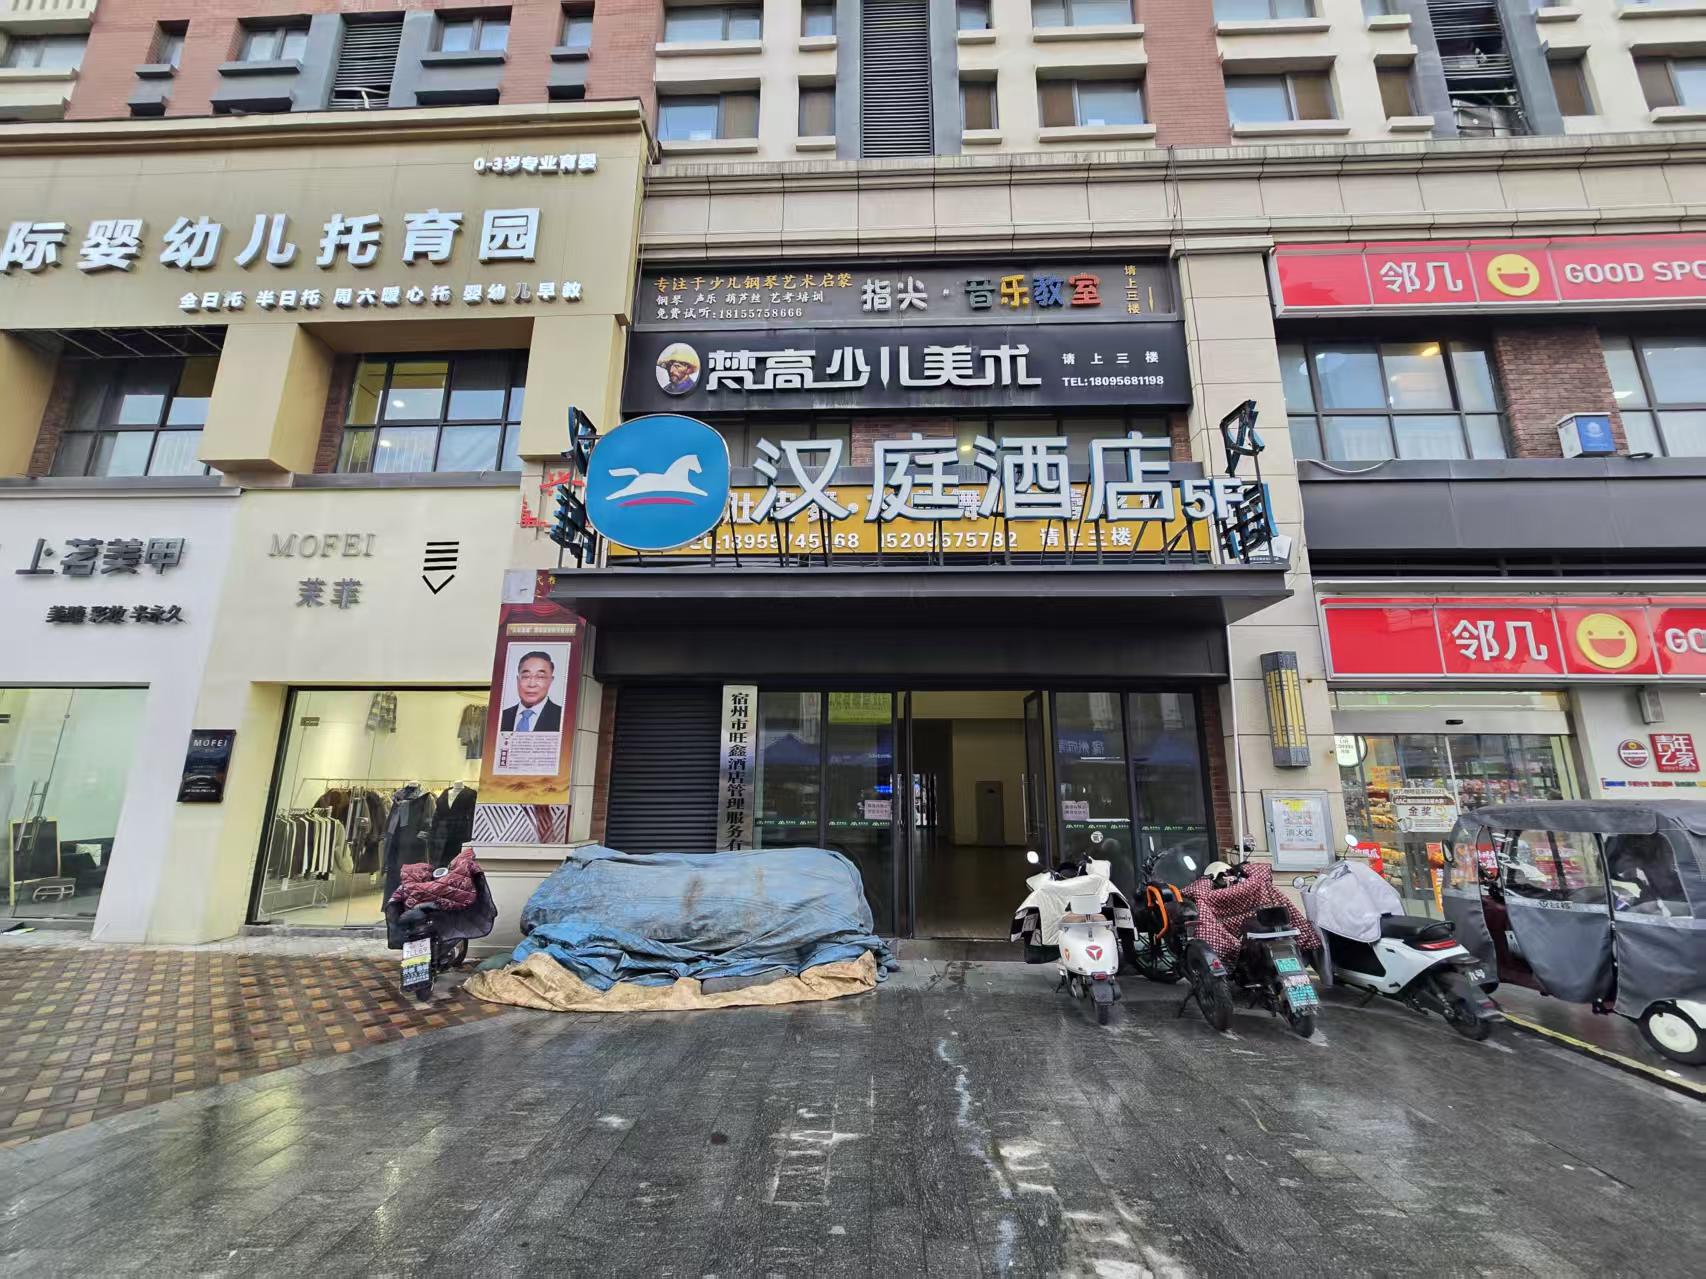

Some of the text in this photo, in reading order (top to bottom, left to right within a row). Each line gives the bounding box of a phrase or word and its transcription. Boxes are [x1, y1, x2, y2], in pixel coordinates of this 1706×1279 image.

[473, 153, 597, 174] 0-3岁专业育婴
[0, 207, 541, 274] 际婴幼儿托育园
[654, 273, 854, 292] 专注于少儿钢琴艺术启蒙
[1380, 260, 1463, 294] 邻几
[1564, 262, 1645, 284] GOOD
[178, 280, 582, 312] 全日托 半日托 周六暖心托 婴幼儿早教
[656, 290, 824, 305] 钢琴 声乐 葫芦丝 艺考培训
[1124, 264, 1141, 314] 请上三楼
[706, 344, 1042, 390] 梵高少儿美术
[1062, 351, 1159, 365] 请上三楼
[1061, 376, 1164, 387] TEL:18095681198
[750, 431, 1175, 522] 汉庭酒店
[1183, 478, 1244, 520] 5F
[267, 533, 376, 558] MOFEI
[1040, 527, 1131, 546] 请上三楼
[129, 604, 186, 624] 半永久
[1452, 618, 1548, 662] 邻几
[193, 739, 228, 747] MOFEI
[1654, 735, 1692, 753] 青年
[1658, 751, 1697, 768] 之家
[1408, 806, 1431, 817] 金奖
